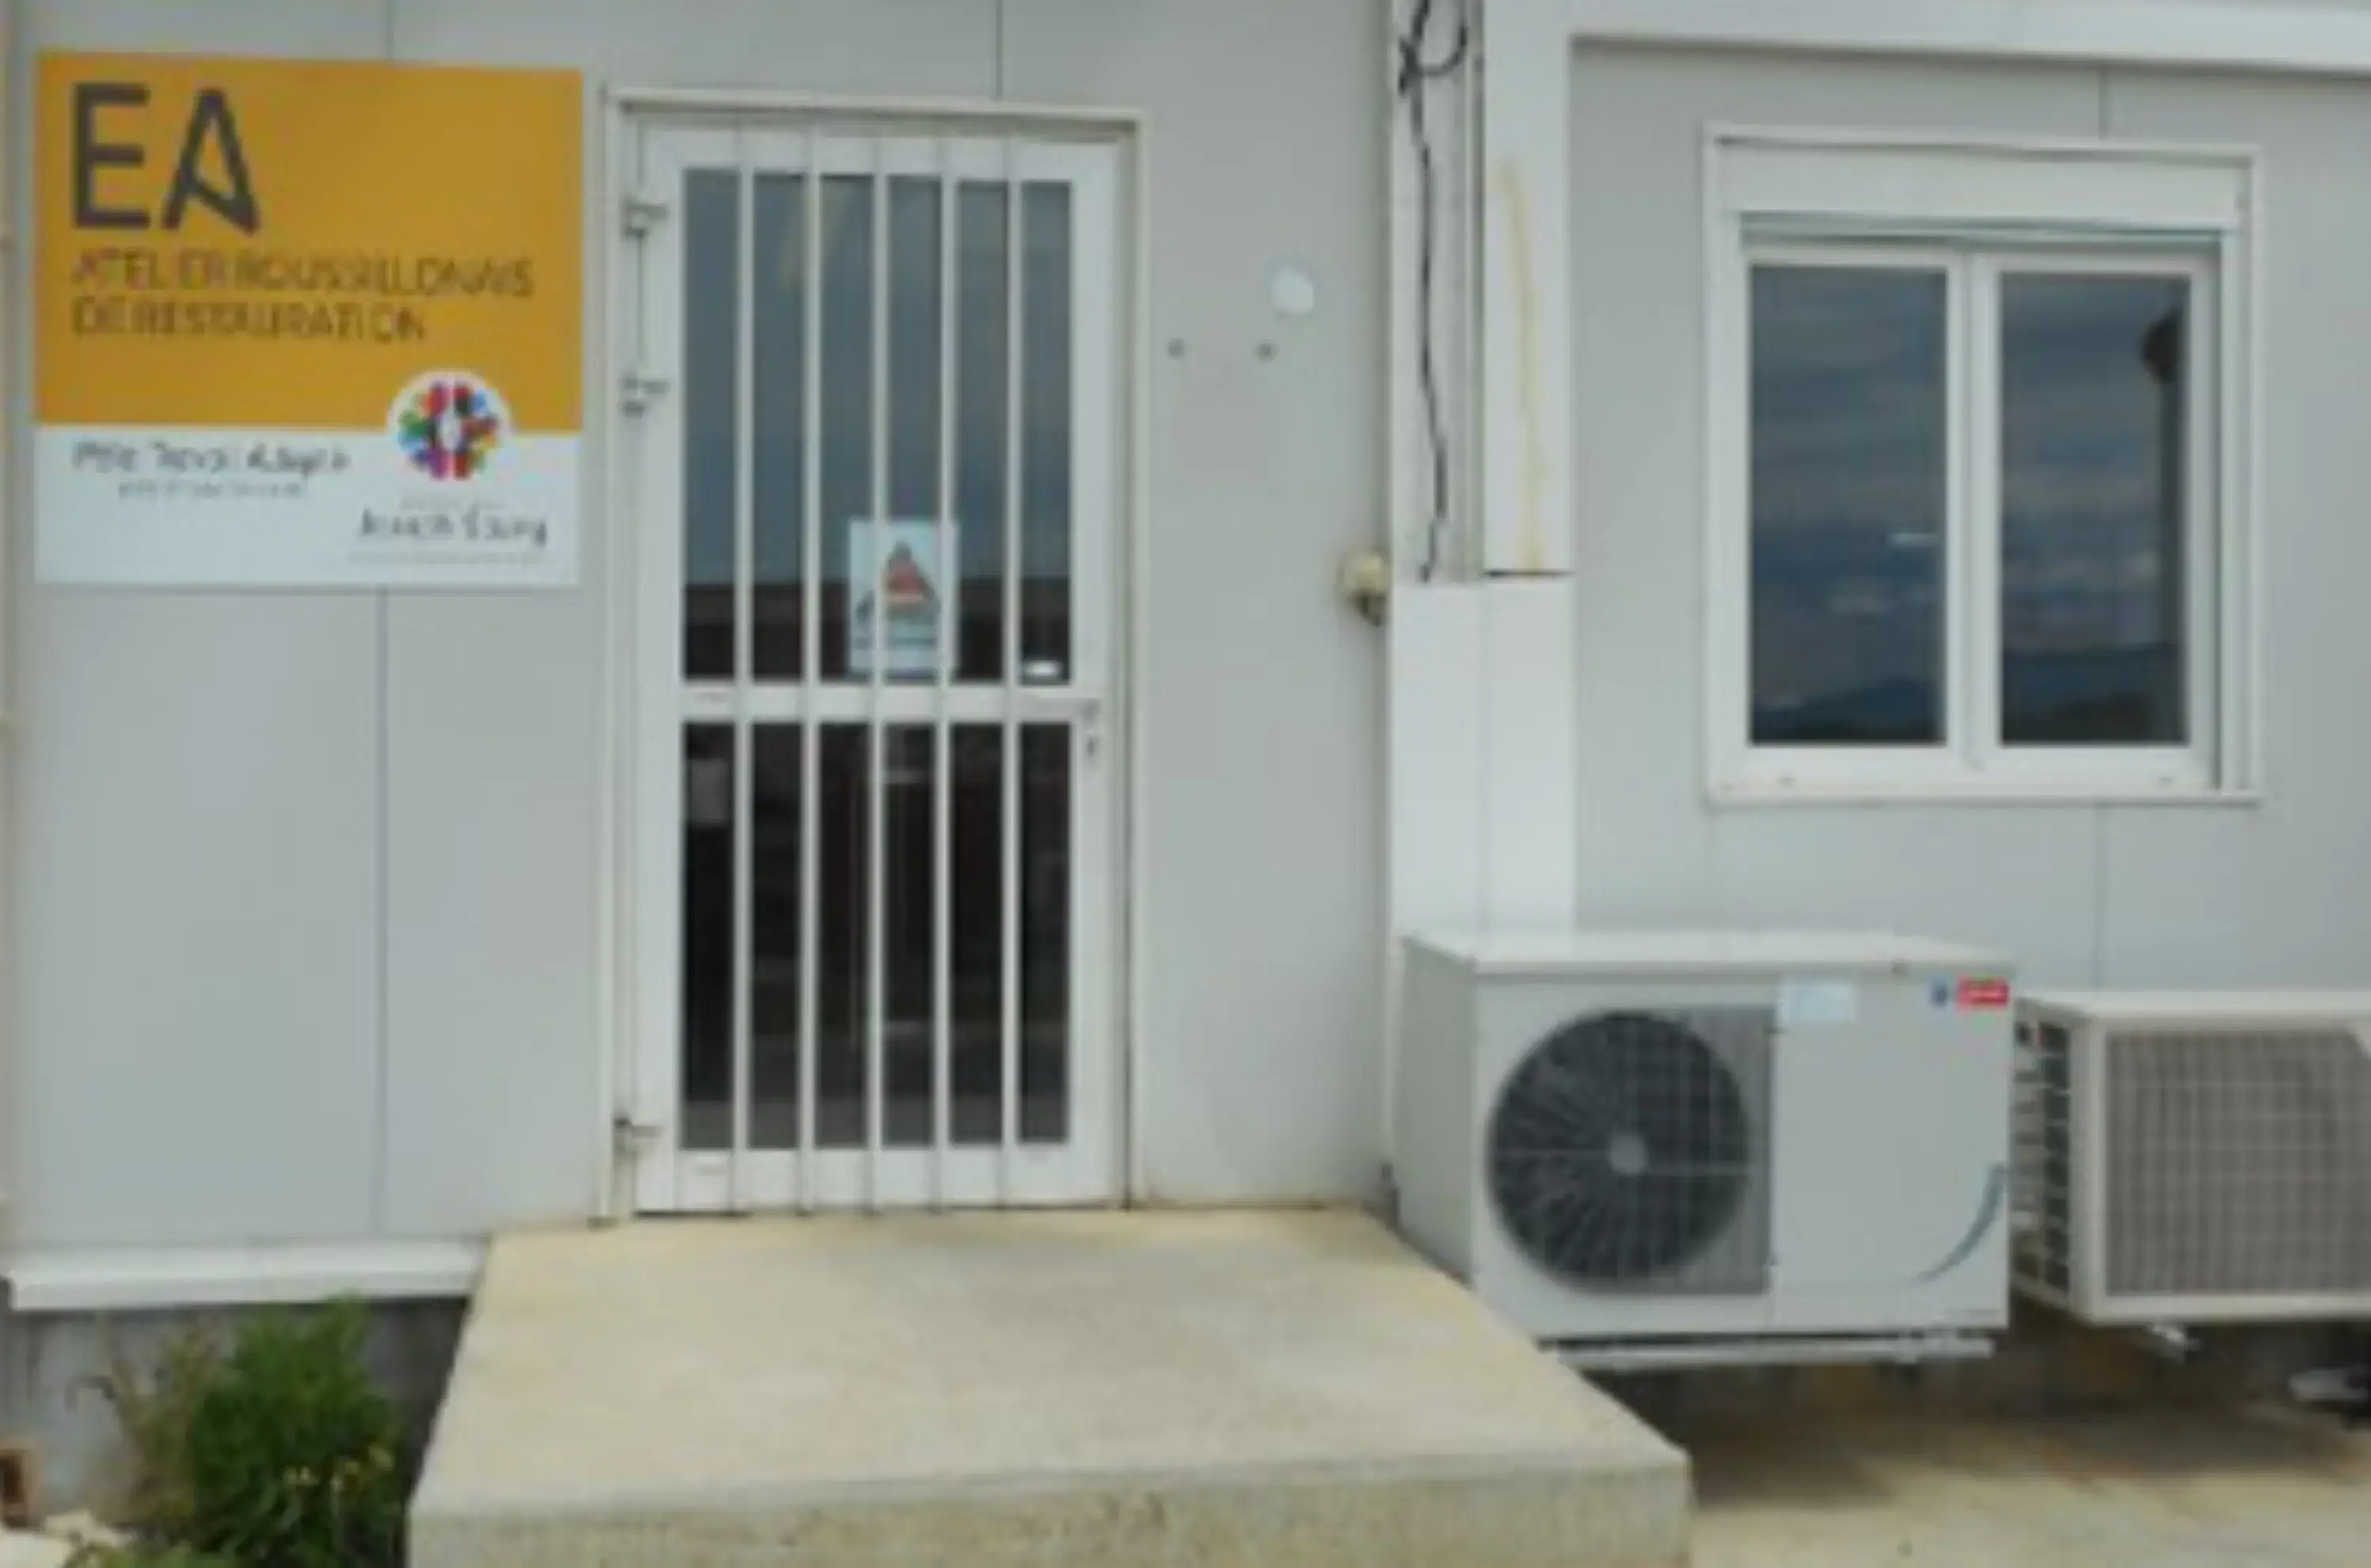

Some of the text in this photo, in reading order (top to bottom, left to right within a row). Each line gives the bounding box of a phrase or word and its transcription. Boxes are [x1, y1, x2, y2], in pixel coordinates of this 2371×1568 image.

[72, 82, 260, 236] EA
[71, 246, 230, 291] ATELIER
[70, 295, 126, 336] DE
